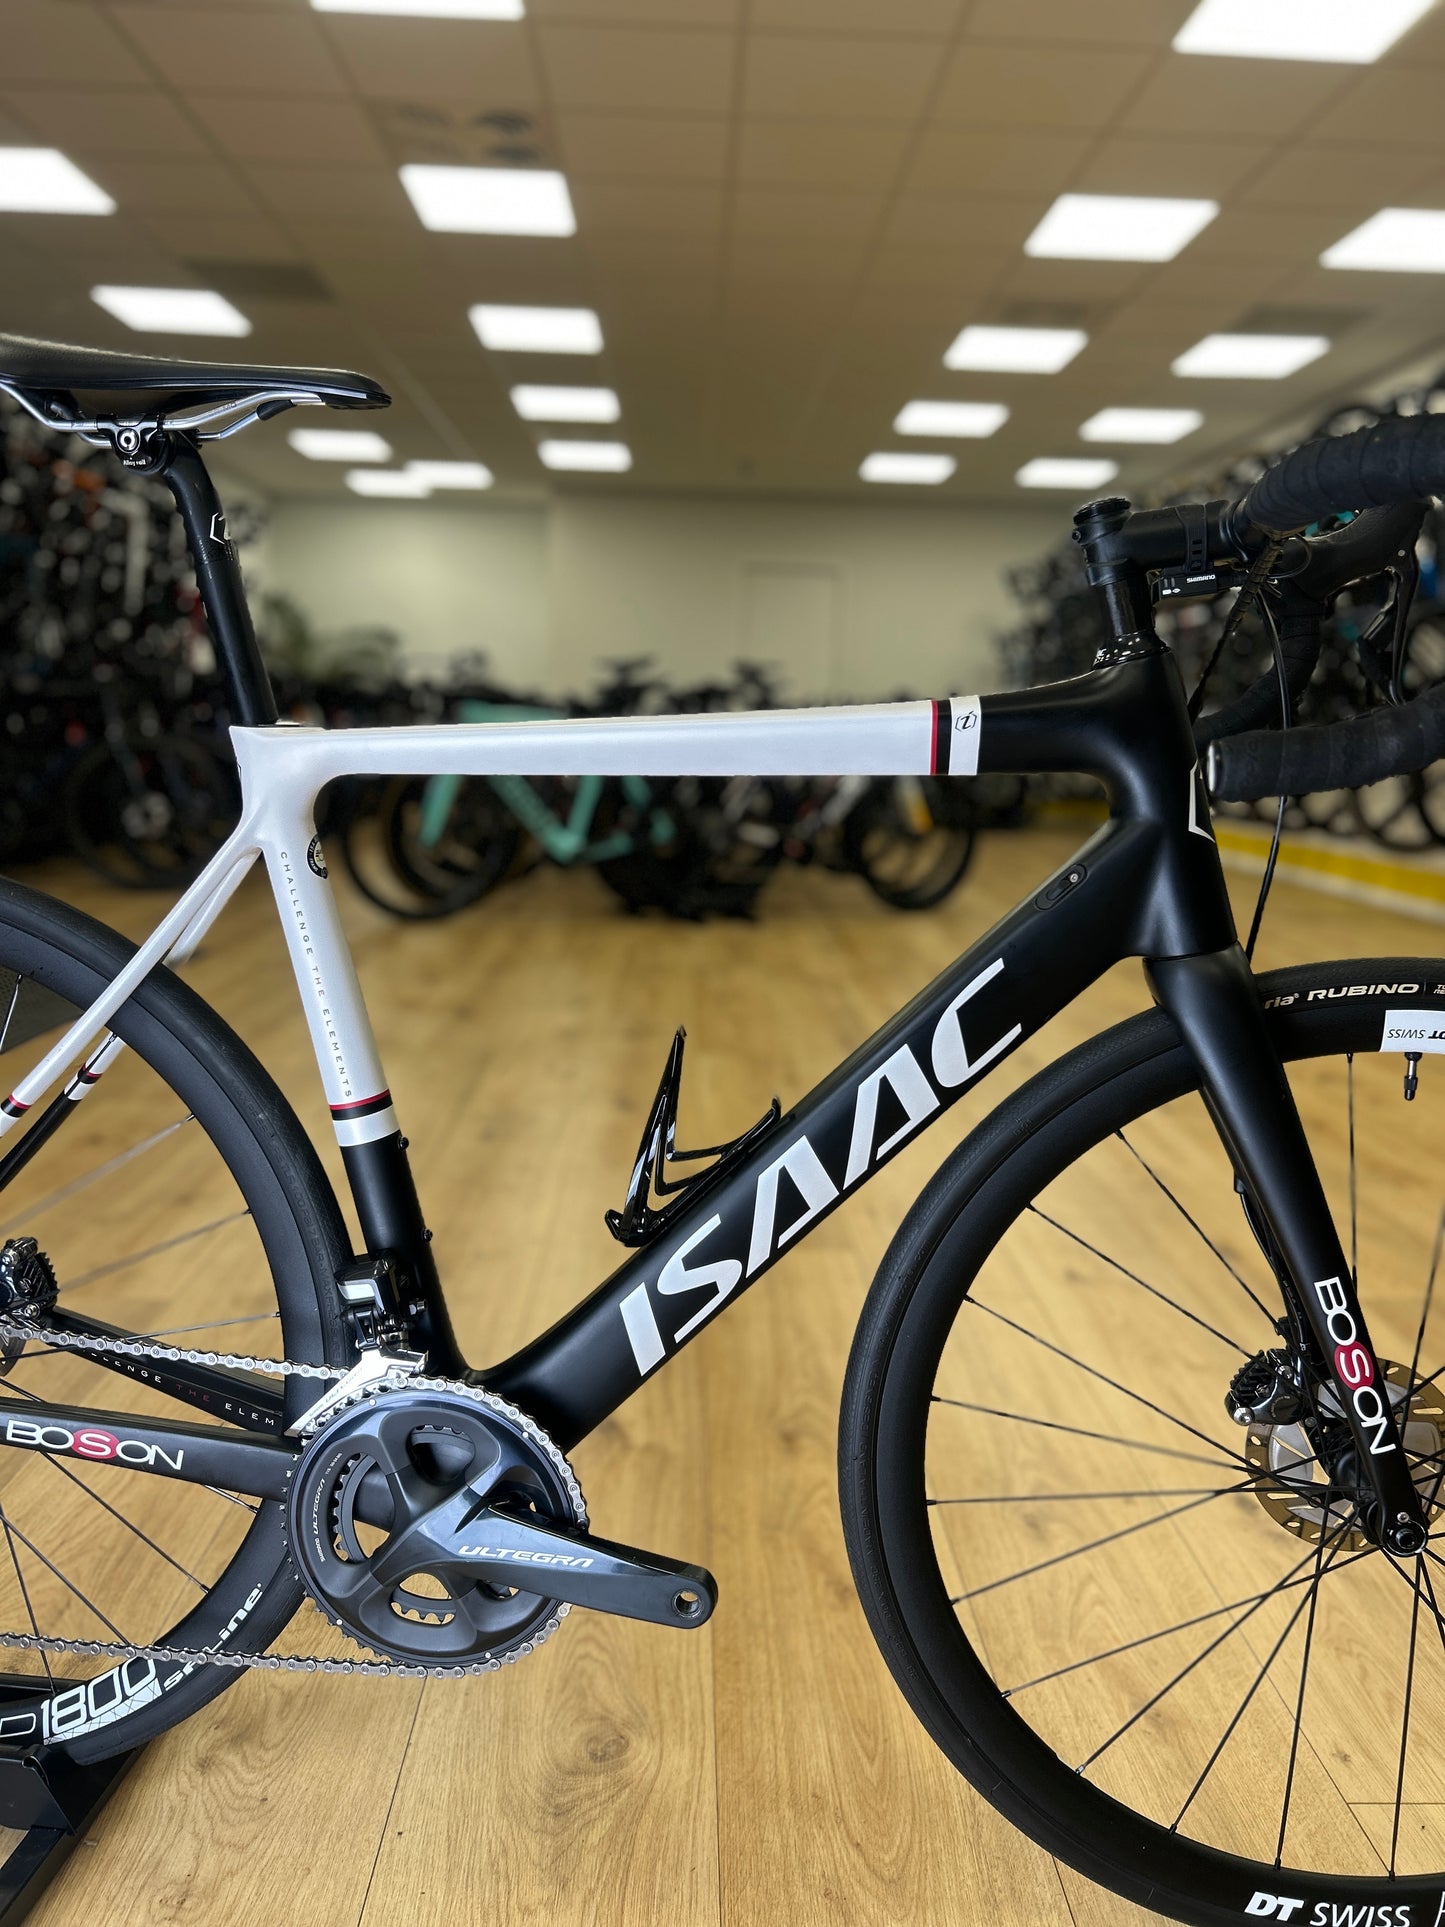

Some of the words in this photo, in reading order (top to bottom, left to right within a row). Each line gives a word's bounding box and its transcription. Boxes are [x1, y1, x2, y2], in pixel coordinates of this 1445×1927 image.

[280, 851, 314, 955] CHALLENGE
[311, 965, 325, 997] THE
[322, 1008, 353, 1098] ELEMENTS
[1306, 983, 1420, 1001] RUBINO
[1387, 1028, 1426, 1039] SWISS
[619, 957, 1022, 1377] ISAAC
[1314, 1276, 1397, 1456] BOSON
[176, 1383, 210, 1402] THE
[6, 1419, 185, 1471] BOSON
[311, 1478, 326, 1535] ULTEGRA
[457, 1545, 594, 1568] ULTEGRA
[40, 1656, 157, 1739] 1800
[1244, 1891, 1305, 1922] DT
[1309, 1902, 1411, 1927] SWISS
